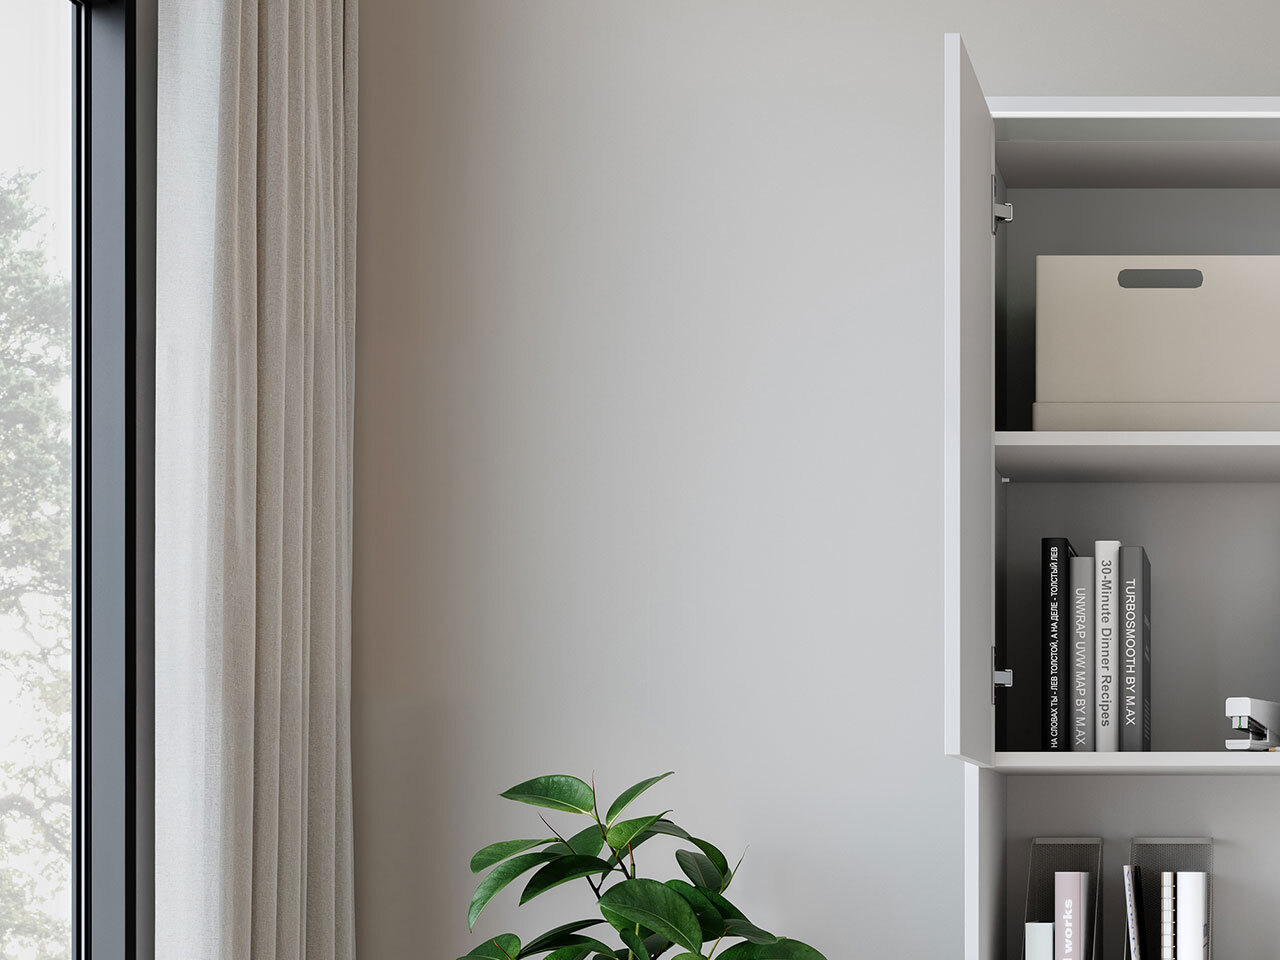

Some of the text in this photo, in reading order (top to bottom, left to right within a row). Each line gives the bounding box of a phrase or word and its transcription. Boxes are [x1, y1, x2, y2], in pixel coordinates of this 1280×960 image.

[1050, 547, 1058, 562] ЛЕВ
[1050, 562, 1058, 596] ТОЛСТЫЙ
[1050, 602, 1060, 622] ДЕЛЕ
[1050, 622, 1058, 632] НА
[1050, 632, 1058, 640] А
[1099, 560, 1112, 727] 30-Minute Dinner Recipes
[1126, 578, 1136, 726] TURBOSMOOTH BY M.AX
[1076, 588, 1086, 745] UNWRAP UVW MAP BY M.AX
[1050, 676, 1058, 690] ЛЕВ
[1050, 696, 1058, 706] ТЫ
[1050, 708, 1058, 736] СЛОВАХ
[1050, 738, 1058, 748] НА
[1062, 898, 1073, 956] works
